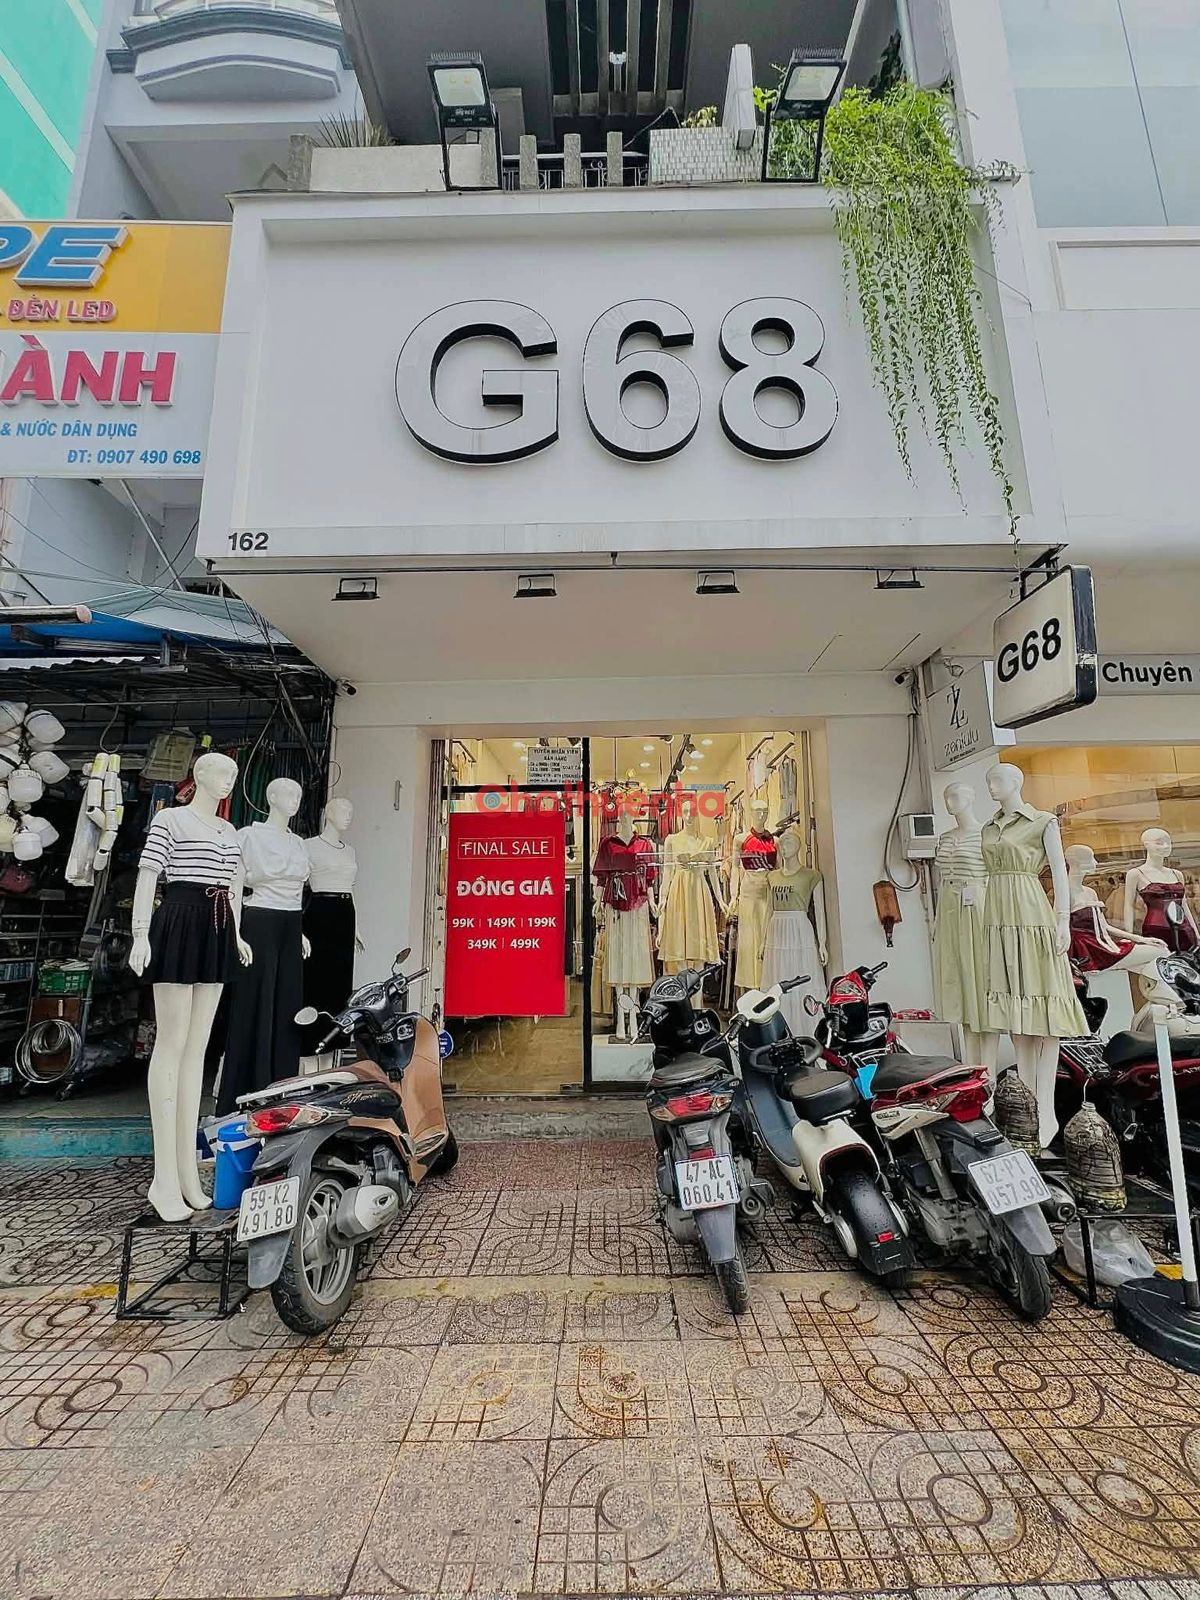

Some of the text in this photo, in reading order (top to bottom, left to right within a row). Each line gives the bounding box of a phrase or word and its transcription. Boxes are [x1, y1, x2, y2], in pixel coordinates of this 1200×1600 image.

[65, 300, 116, 322] LED
[395, 297, 838, 465] G68
[97, 423, 137, 439] DỤNG
[68, 450, 201, 464] ĐT: 0907 490 698
[228, 532, 269, 551] 162
[997, 617, 1062, 683] G68
[1102, 661, 1193, 687] Chuyên
[462, 840, 549, 856] FINAL SALE
[457, 875, 554, 896] ĐỒNG GIÁ
[452, 916, 556, 928] 99K 149K 199K
[467, 938, 540, 949] 349K 499K
[686, 1160, 725, 1183] 47-AC
[250, 1183, 290, 1212] 59-K2
[683, 1180, 735, 1206] 060.41
[242, 1204, 294, 1236] 491.80
